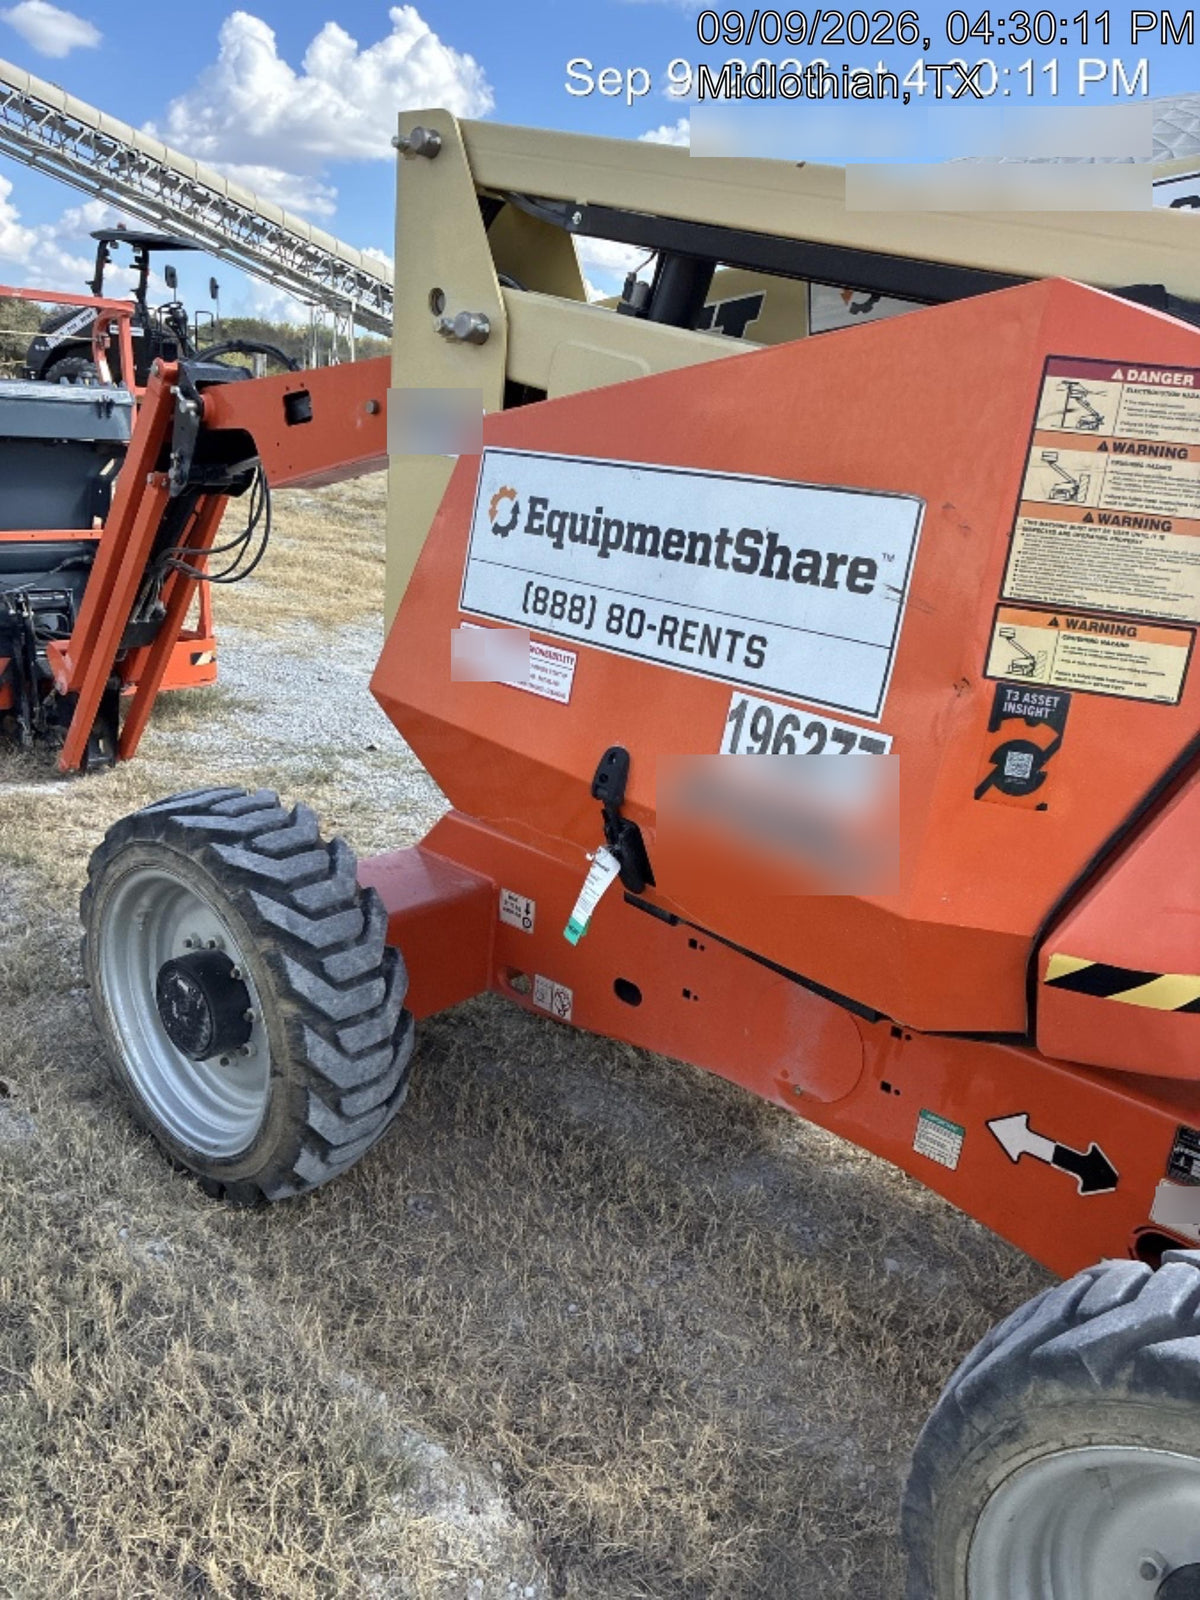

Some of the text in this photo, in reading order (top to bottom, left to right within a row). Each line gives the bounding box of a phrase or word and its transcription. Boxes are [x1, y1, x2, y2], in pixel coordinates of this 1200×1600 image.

[1127, 369, 1194, 386] DANGER
[1112, 441, 1188, 460] WARNING
[1098, 513, 1172, 532] WARNING
[524, 495, 877, 595] EquipmentShare
[522, 580, 768, 669] (888) 80-RENTS
[1066, 618, 1138, 637] WARNING
[1005, 689, 1060, 709] T3 ASSET
[1002, 701, 1050, 719] INSIGHT
